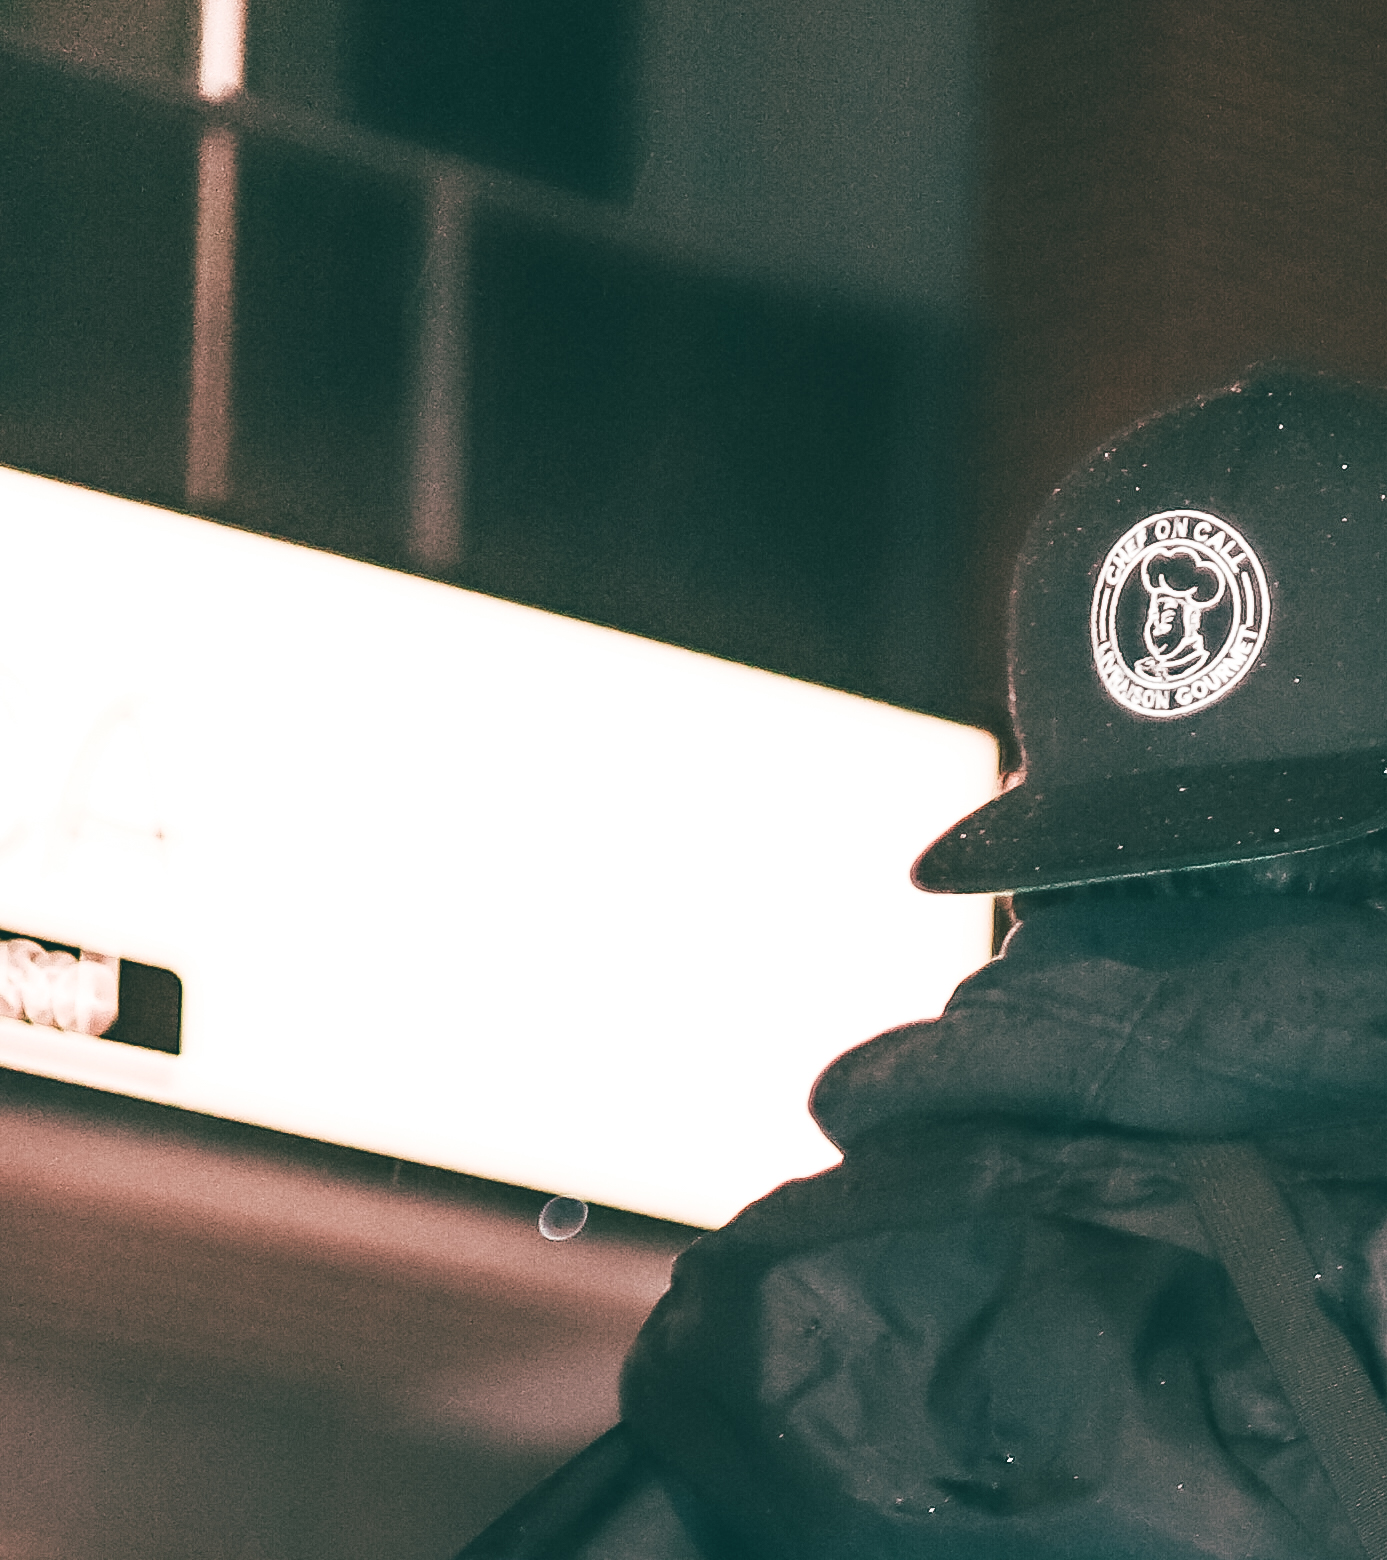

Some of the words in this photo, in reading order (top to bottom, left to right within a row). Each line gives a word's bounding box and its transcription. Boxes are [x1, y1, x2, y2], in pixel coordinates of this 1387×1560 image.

[1106, 527, 1147, 585] CHEF
[1155, 517, 1190, 540] ON
[1193, 521, 1246, 573] CALL
[1174, 624, 1258, 705] GOURMET
